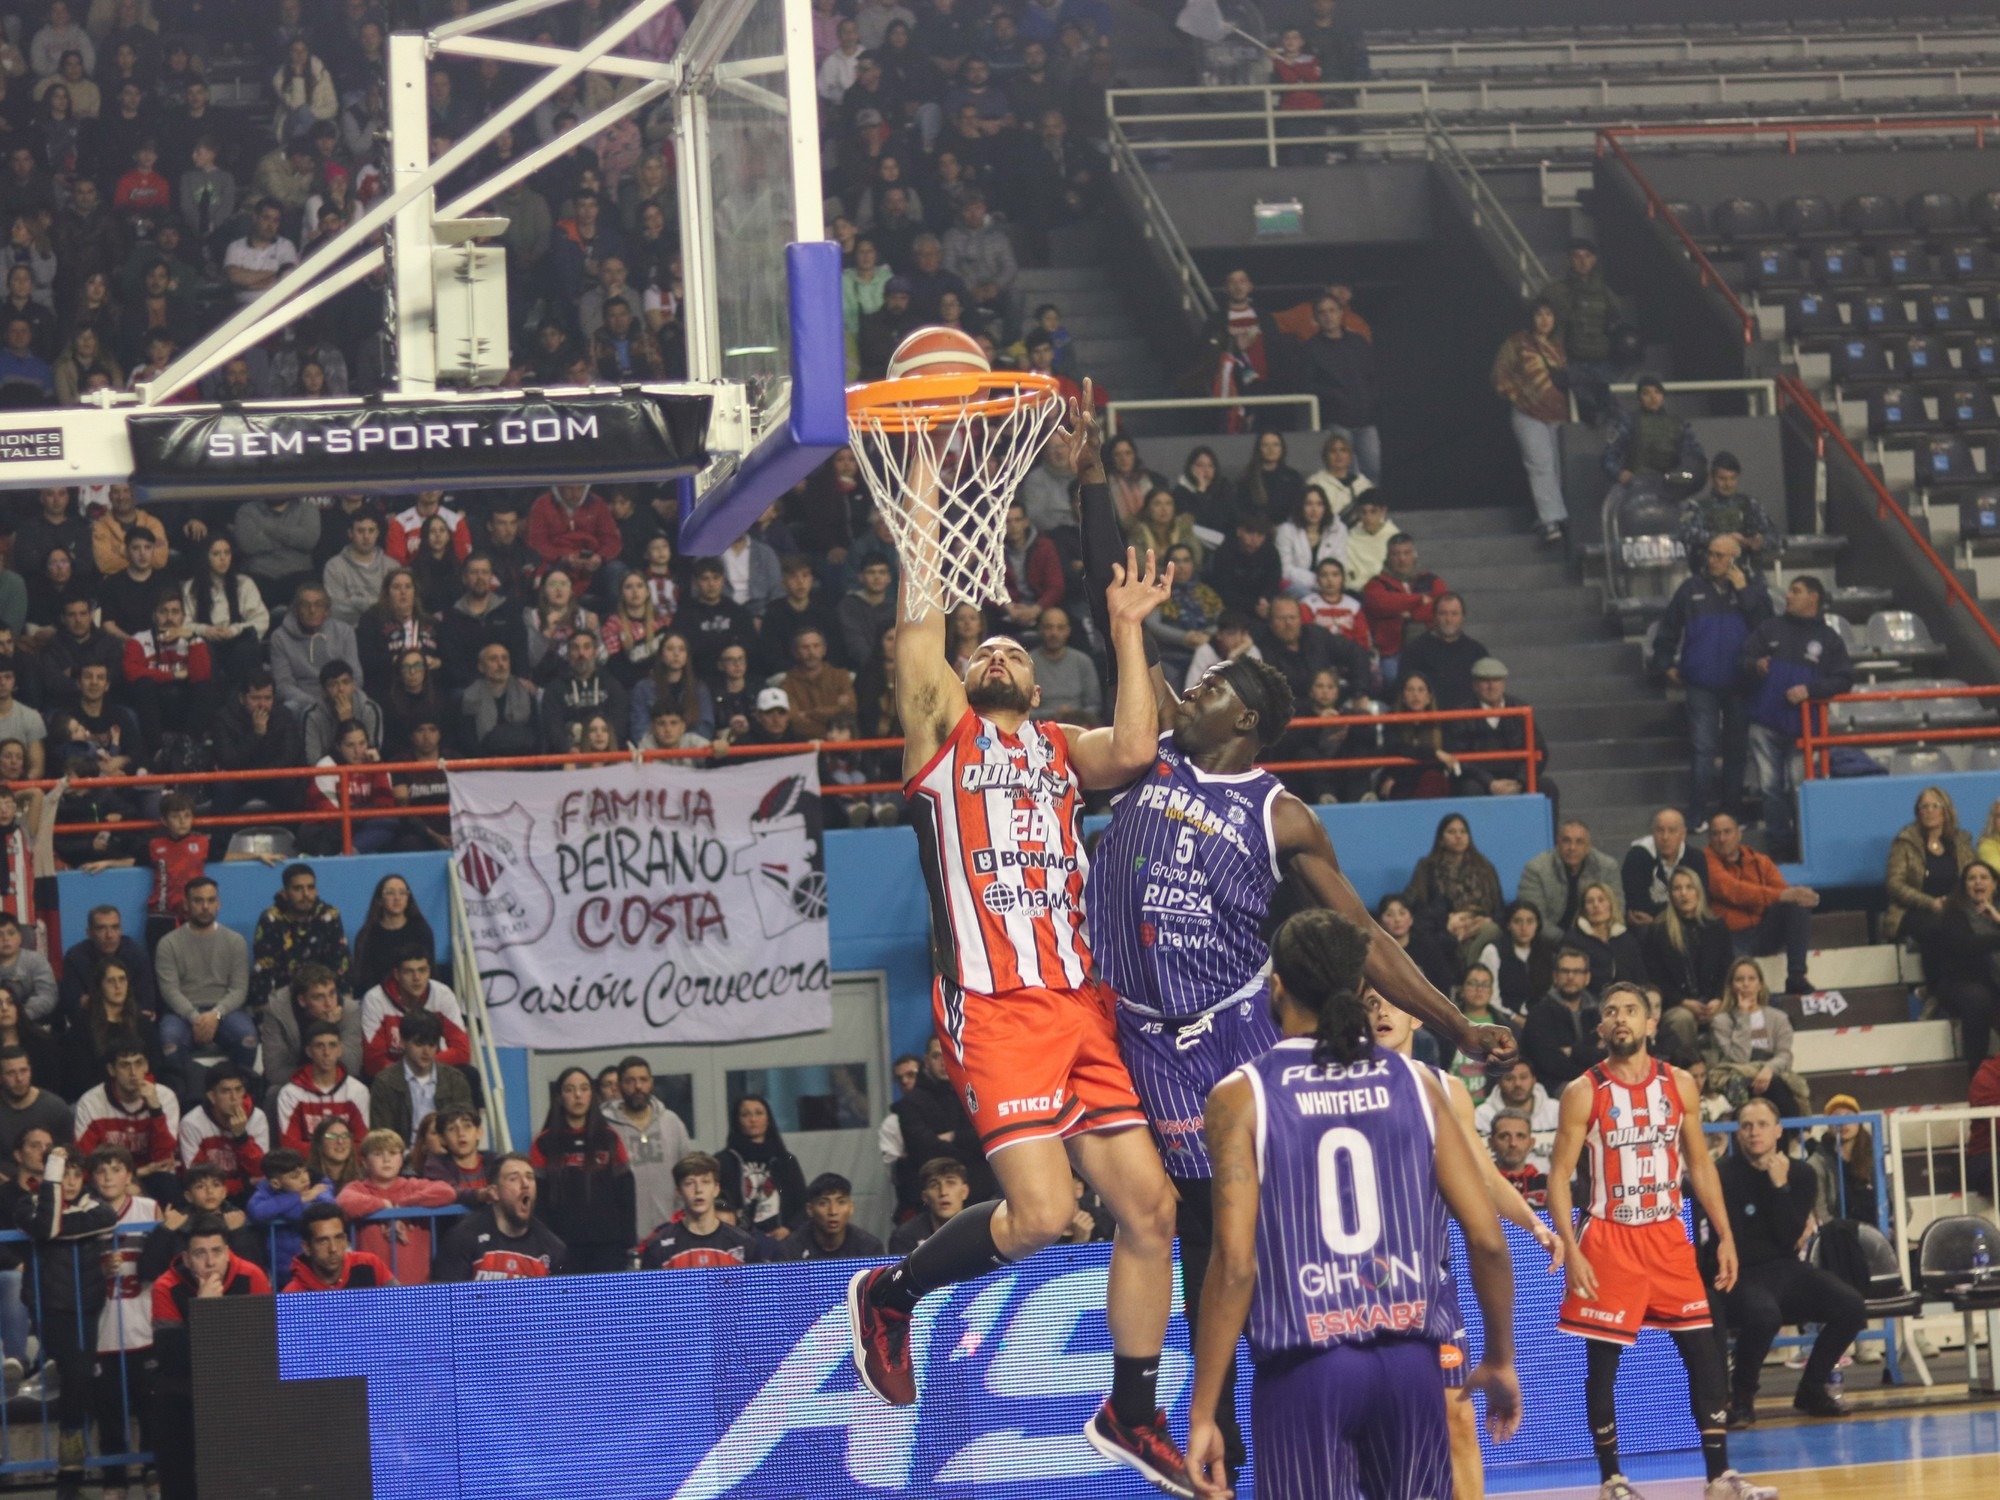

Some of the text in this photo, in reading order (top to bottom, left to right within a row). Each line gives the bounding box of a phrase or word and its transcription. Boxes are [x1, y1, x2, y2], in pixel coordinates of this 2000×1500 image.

[208, 415, 599, 457] SEM-SPORT.COM
[558, 787, 717, 835] FAMILIA
[1009, 808, 1049, 843] 28
[556, 825, 728, 895] PEIRANO
[1174, 826, 1195, 864] 5
[1150, 861, 1188, 883] Grupo
[1017, 884, 1074, 912] hawk
[1143, 883, 1214, 915] RIPSA
[576, 890, 729, 950] COSTA
[1175, 914, 1186, 923] DE
[1158, 926, 1217, 950] hawk
[643, 957, 832, 1029] Cervecera
[998, 1096, 1050, 1117] STIKO
[1295, 1086, 1390, 1116] WHITFIELD
[1155, 1116, 1205, 1136] ESKA
[1317, 1127, 1382, 1256] 0
[1299, 1251, 1421, 1297] GIHON
[1306, 1299, 1427, 1342] ESKABE
